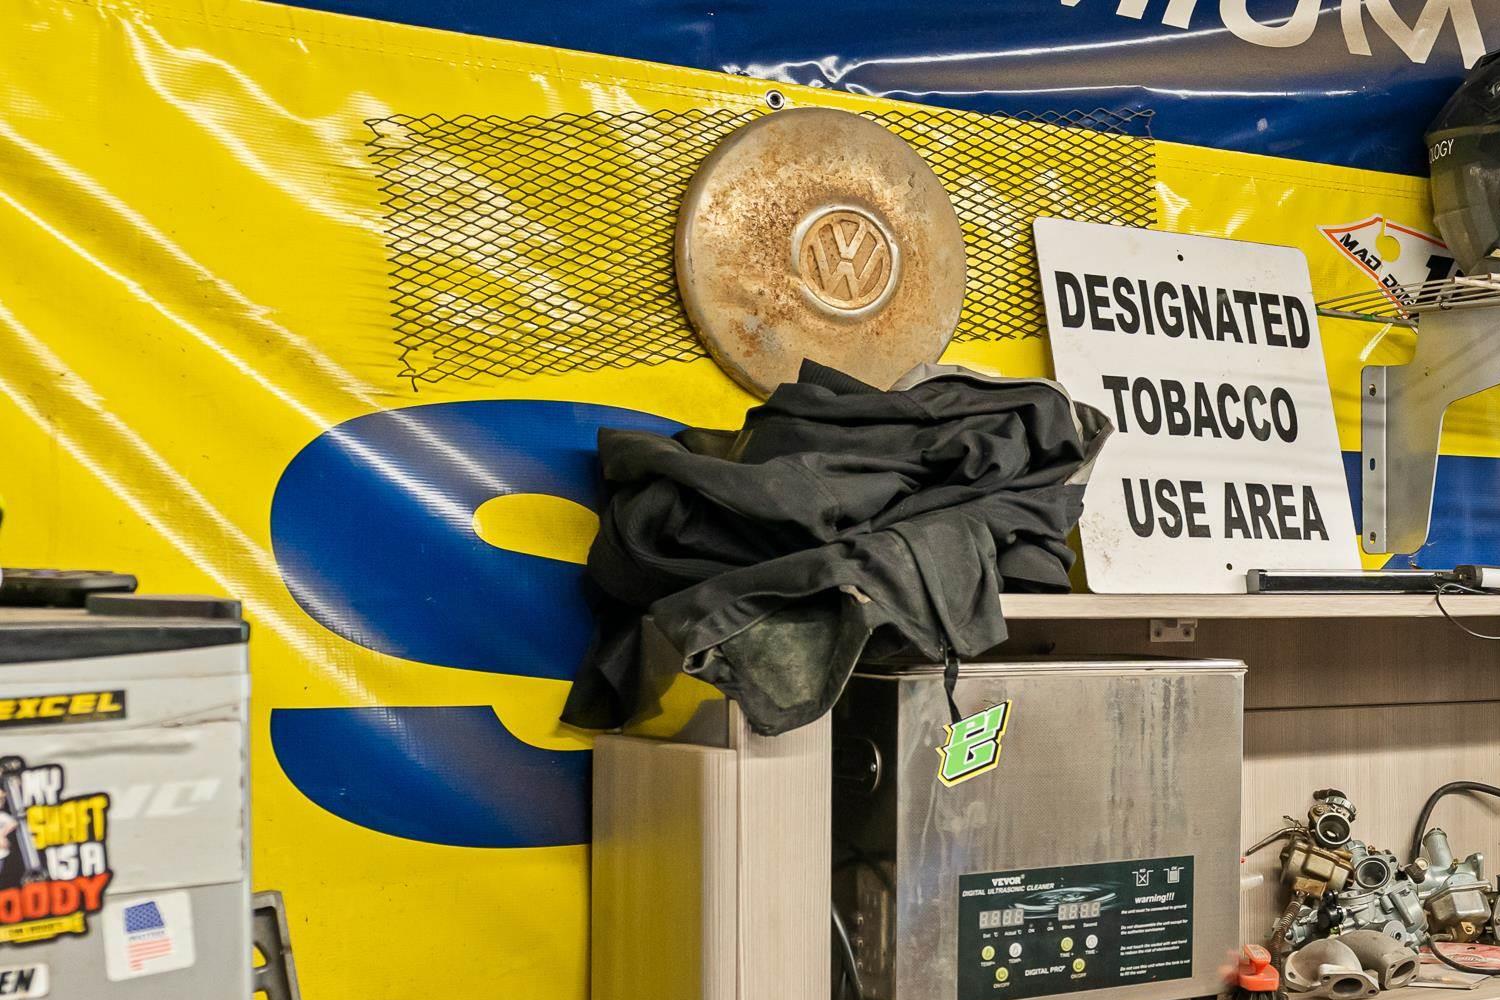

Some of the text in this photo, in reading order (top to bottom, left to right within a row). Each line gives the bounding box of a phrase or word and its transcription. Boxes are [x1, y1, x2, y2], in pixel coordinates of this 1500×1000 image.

[1339, 232, 1382, 272] MAD
[1054, 270, 1311, 349] DESIGNATED
[1101, 375, 1299, 443] TOBACCO
[1121, 477, 1330, 541] USE AREA
[0, 691, 122, 721] EXCEL
[20, 766, 63, 806] MY
[26, 793, 110, 850] SHAFT
[45, 841, 107, 881] IS A
[962, 882, 1055, 897] DIGITAL ULTRASONIC CLEANER
[991, 876, 1021, 887] VEVOR
[1135, 892, 1175, 903] warning!!!
[1024, 967, 1049, 976] DIGITAL
